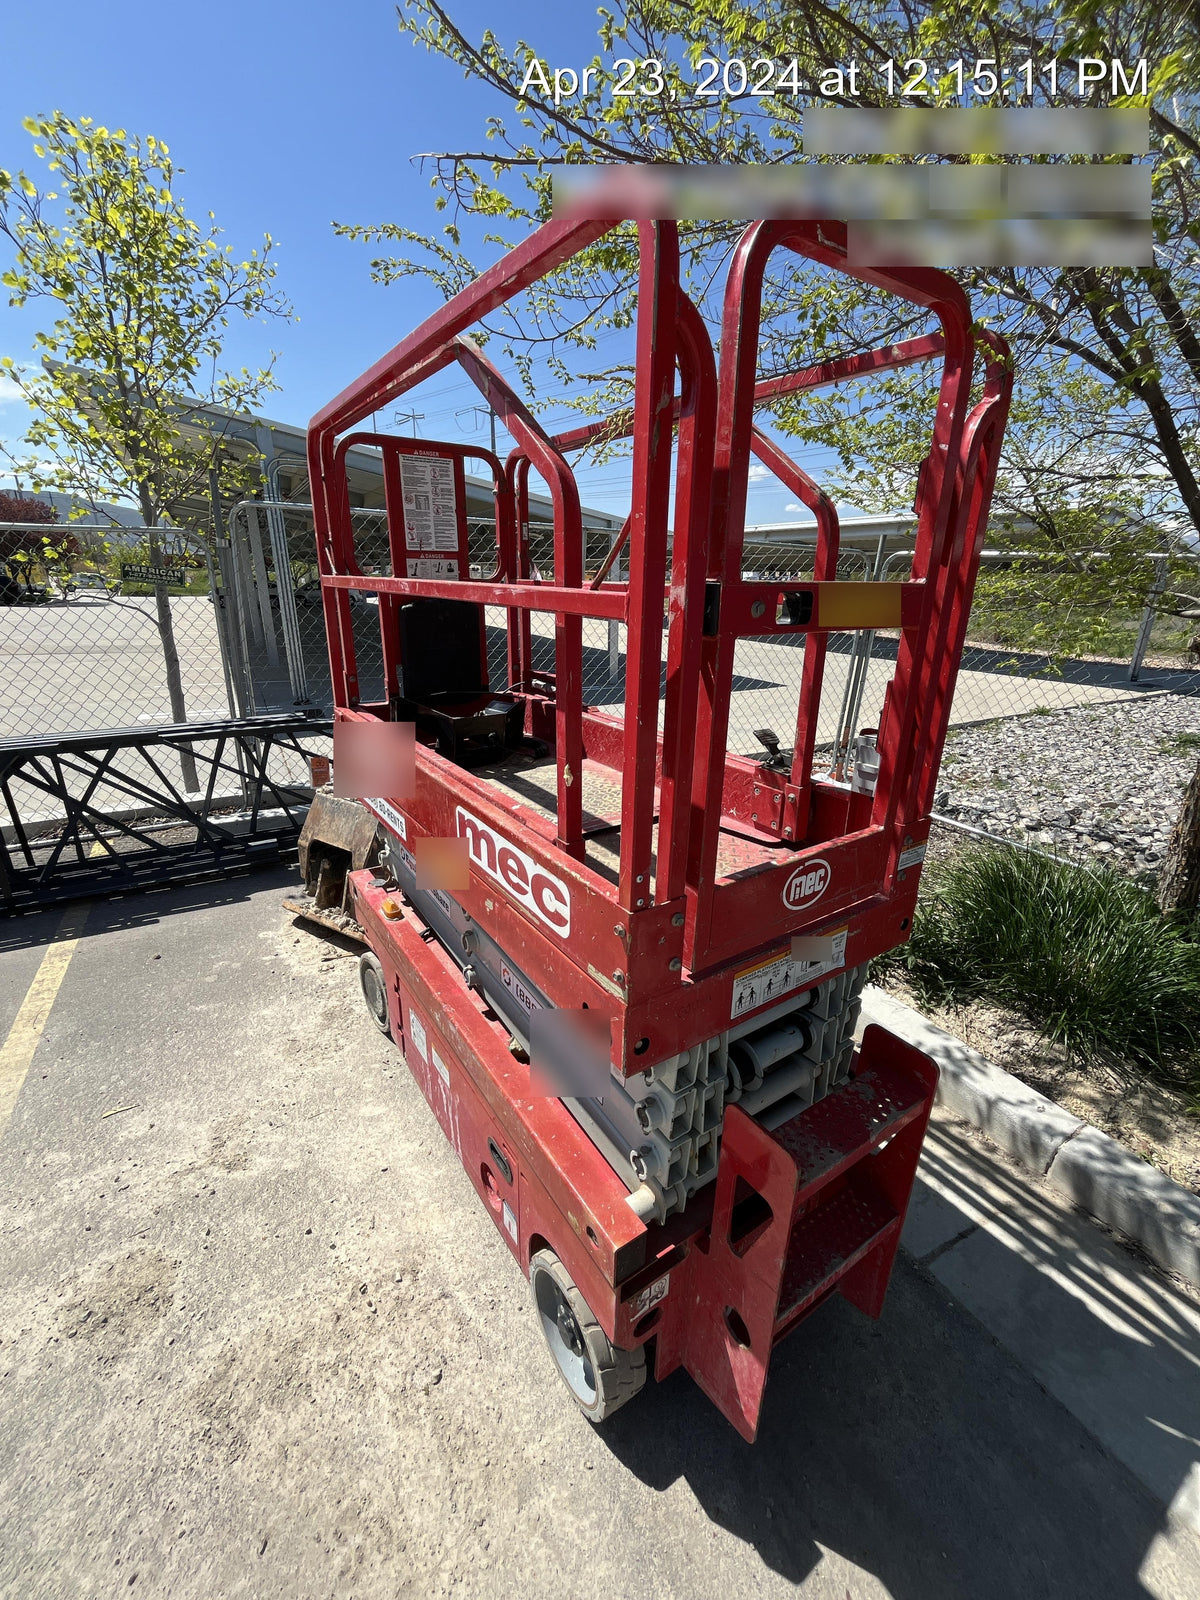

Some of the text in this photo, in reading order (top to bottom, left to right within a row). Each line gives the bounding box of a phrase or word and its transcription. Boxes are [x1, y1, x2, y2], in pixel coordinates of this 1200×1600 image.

[124, 565, 181, 577] AMERICAN
[457, 809, 569, 928] mec
[789, 868, 826, 902] mec
